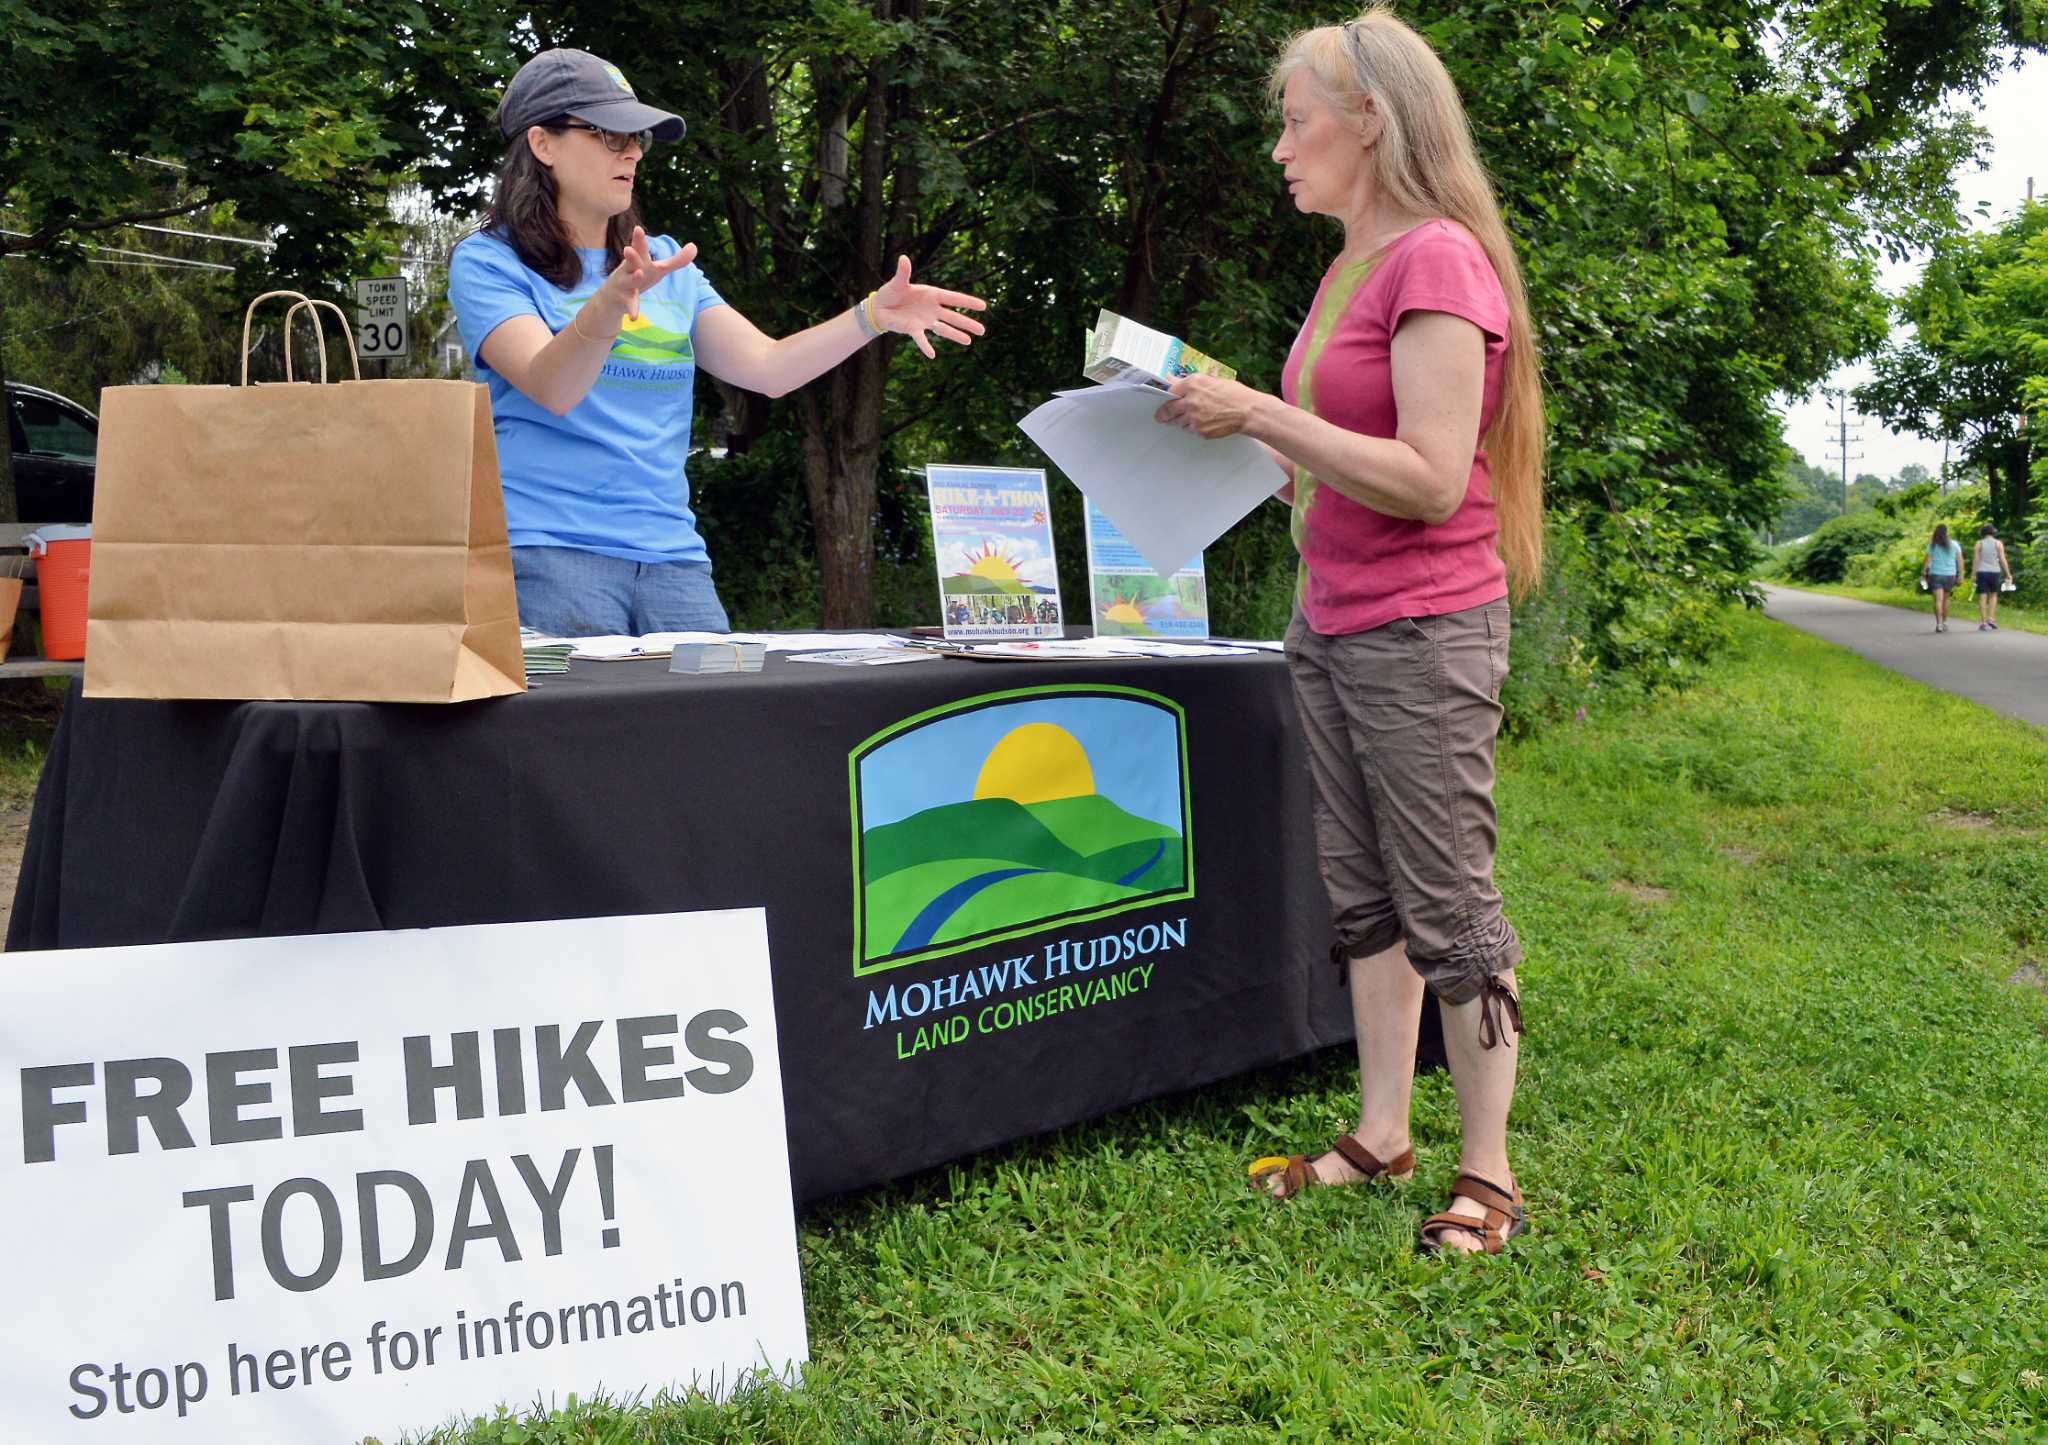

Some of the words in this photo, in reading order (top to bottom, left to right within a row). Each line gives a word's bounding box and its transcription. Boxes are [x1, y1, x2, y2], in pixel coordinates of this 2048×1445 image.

[363, 322, 402, 351] 30
[366, 296, 398, 305] SPEED
[368, 284, 396, 293] TOWN
[369, 308, 394, 318] LIMIT
[863, 954, 1037, 1030] MOHAWK
[1044, 918, 1187, 980] HUDSON
[896, 1015, 970, 1059] LAND
[978, 963, 1154, 1033] CONSERVANCY
[20, 1041, 364, 1164] FREE
[403, 1009, 753, 1125] HIKES
[183, 1145, 620, 1301] TODAY!
[69, 1362, 207, 1419] Stop
[228, 1342, 351, 1396] here
[367, 1321, 442, 1374] for
[458, 1279, 746, 1360] information
